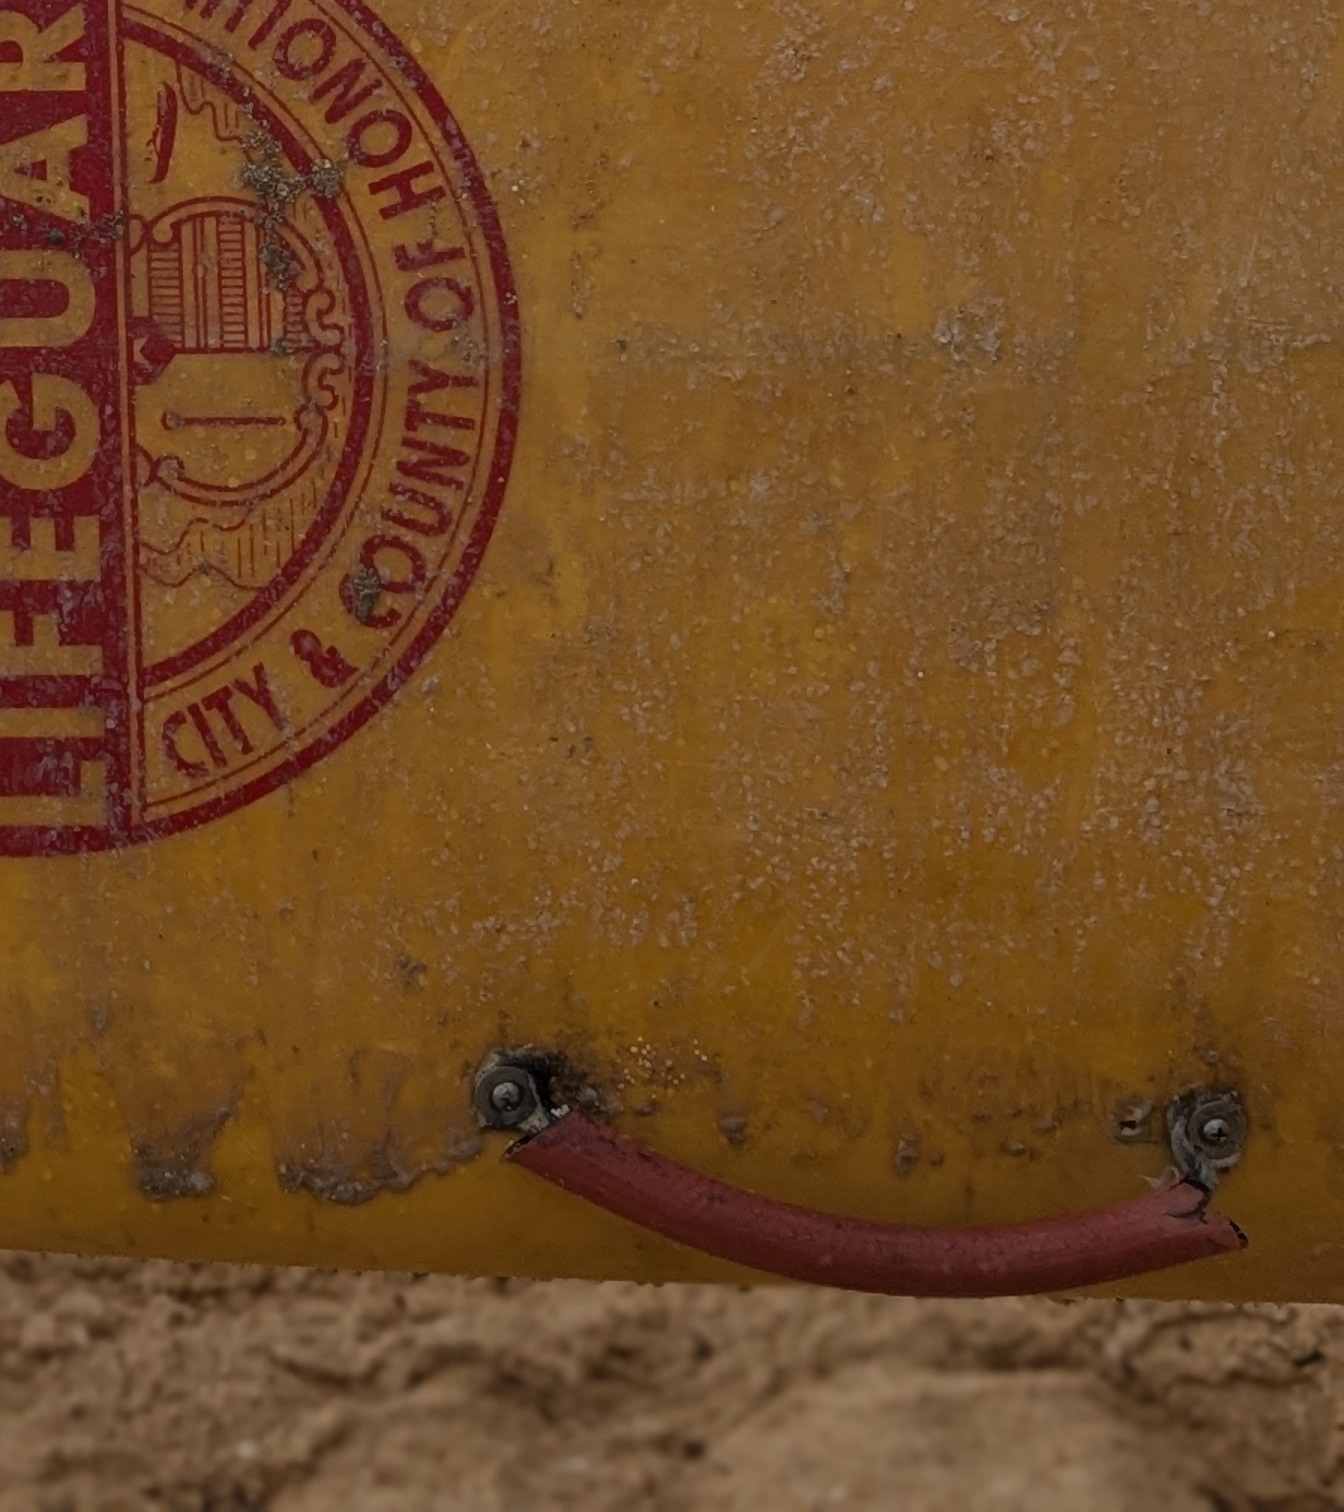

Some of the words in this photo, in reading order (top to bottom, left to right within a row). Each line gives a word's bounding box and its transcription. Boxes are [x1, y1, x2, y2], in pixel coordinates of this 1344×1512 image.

[393, 238, 475, 335] OF
[338, 367, 477, 629] COUNTY
[290, 627, 359, 689] &
[159, 660, 297, 778] CITY
